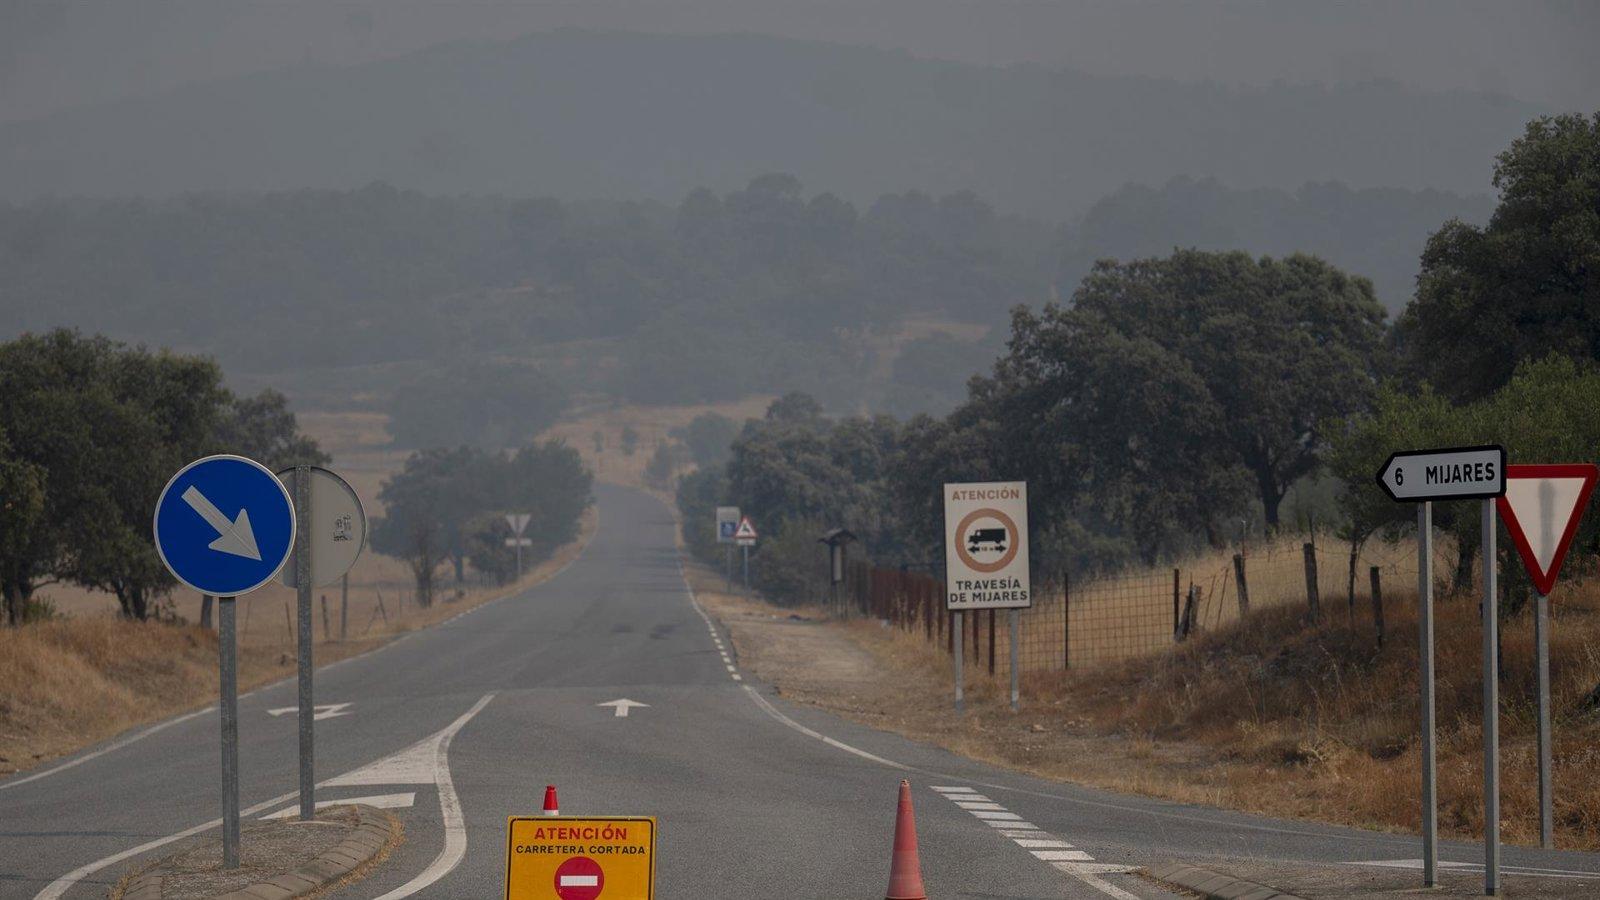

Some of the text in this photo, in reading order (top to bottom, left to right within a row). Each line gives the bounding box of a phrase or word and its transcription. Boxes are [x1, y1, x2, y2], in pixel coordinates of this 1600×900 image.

[1394, 462, 1495, 486] 6 MIJARES
[952, 487, 1020, 500] ATENCIÓN
[956, 576, 1021, 590] TRAVESÍA
[950, 591, 1028, 603] DE MIJARES
[534, 824, 627, 840] ATENCIÓN
[516, 845, 646, 855] CARRETERA CORTADA
